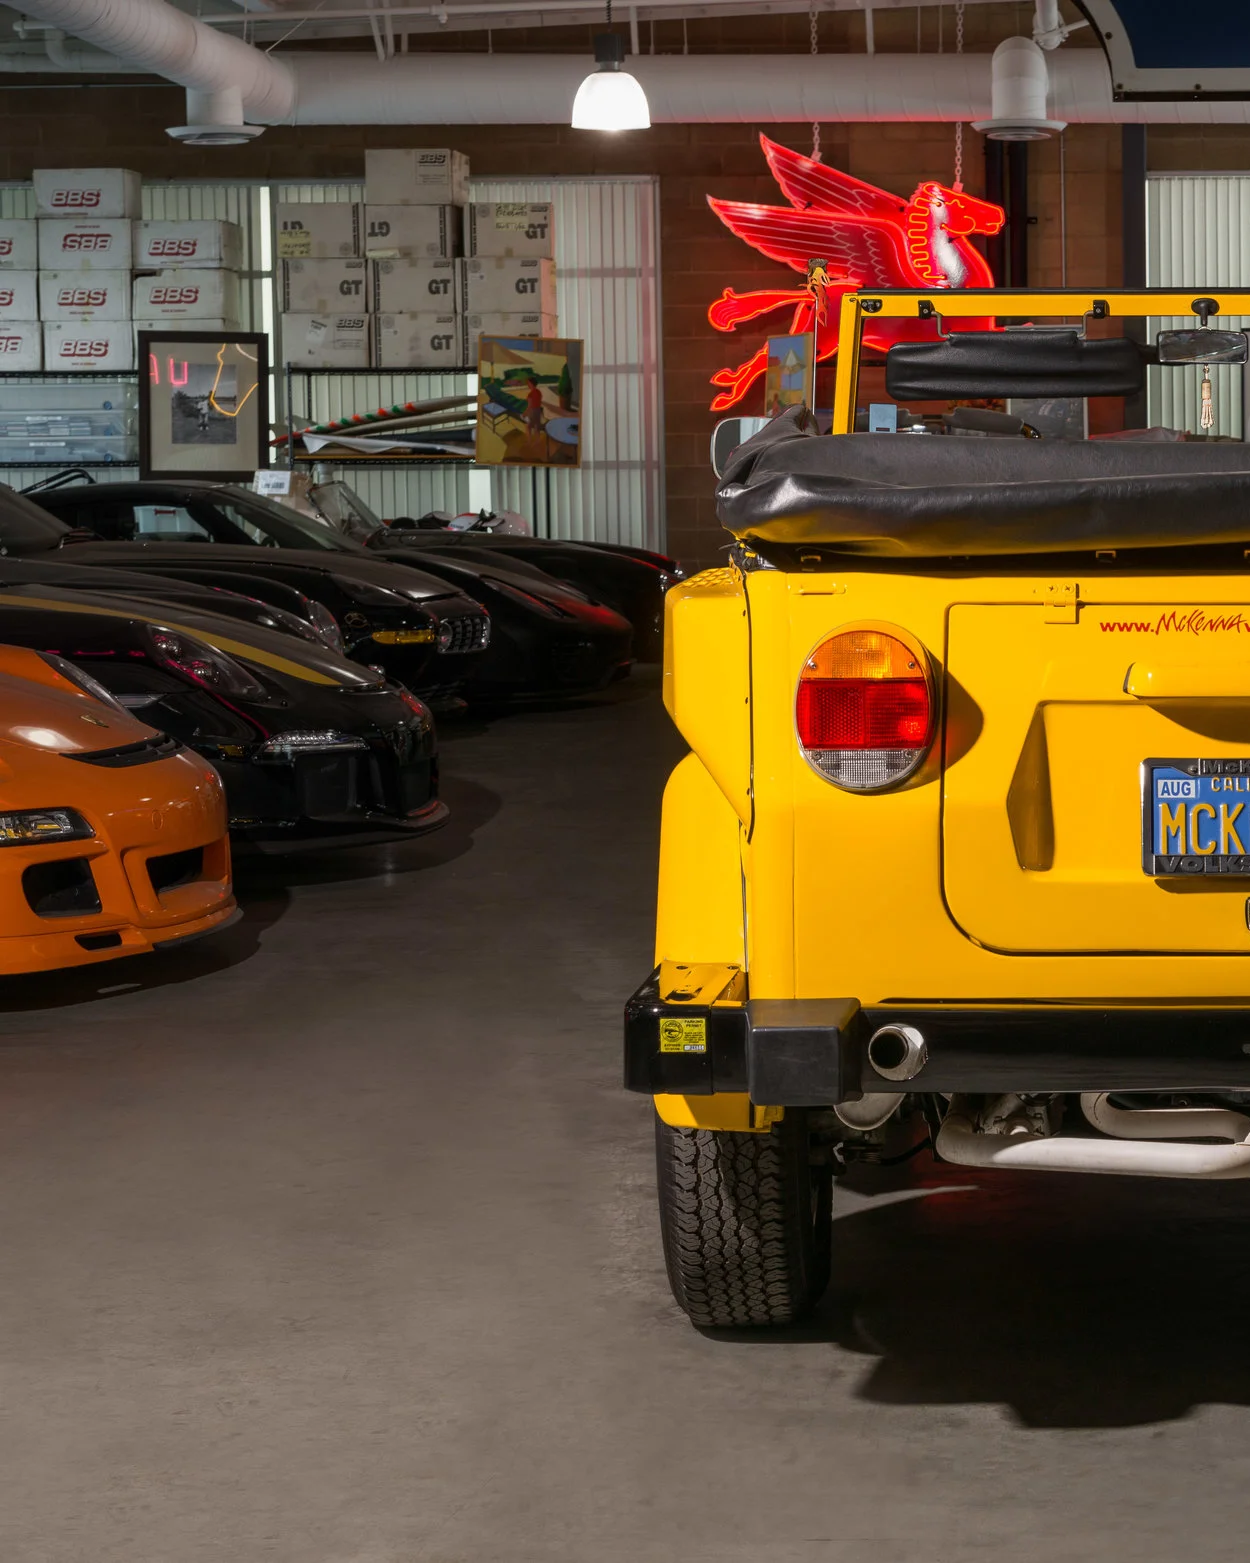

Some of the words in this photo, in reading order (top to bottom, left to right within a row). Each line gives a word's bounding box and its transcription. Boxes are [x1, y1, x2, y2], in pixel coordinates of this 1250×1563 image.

[51, 189, 101, 207] BBS
[368, 221, 391, 238] GT
[525, 223, 548, 240] GT
[62, 233, 112, 252] BBS
[148, 238, 198, 256] BBS
[339, 279, 362, 296] GT
[428, 279, 451, 295] GT
[515, 277, 538, 294] GT
[57, 288, 107, 307] BBS
[149, 286, 199, 305] BBS
[60, 339, 109, 357] BBS
[430, 334, 453, 351] GT
[1160, 781, 1192, 797] AUG
